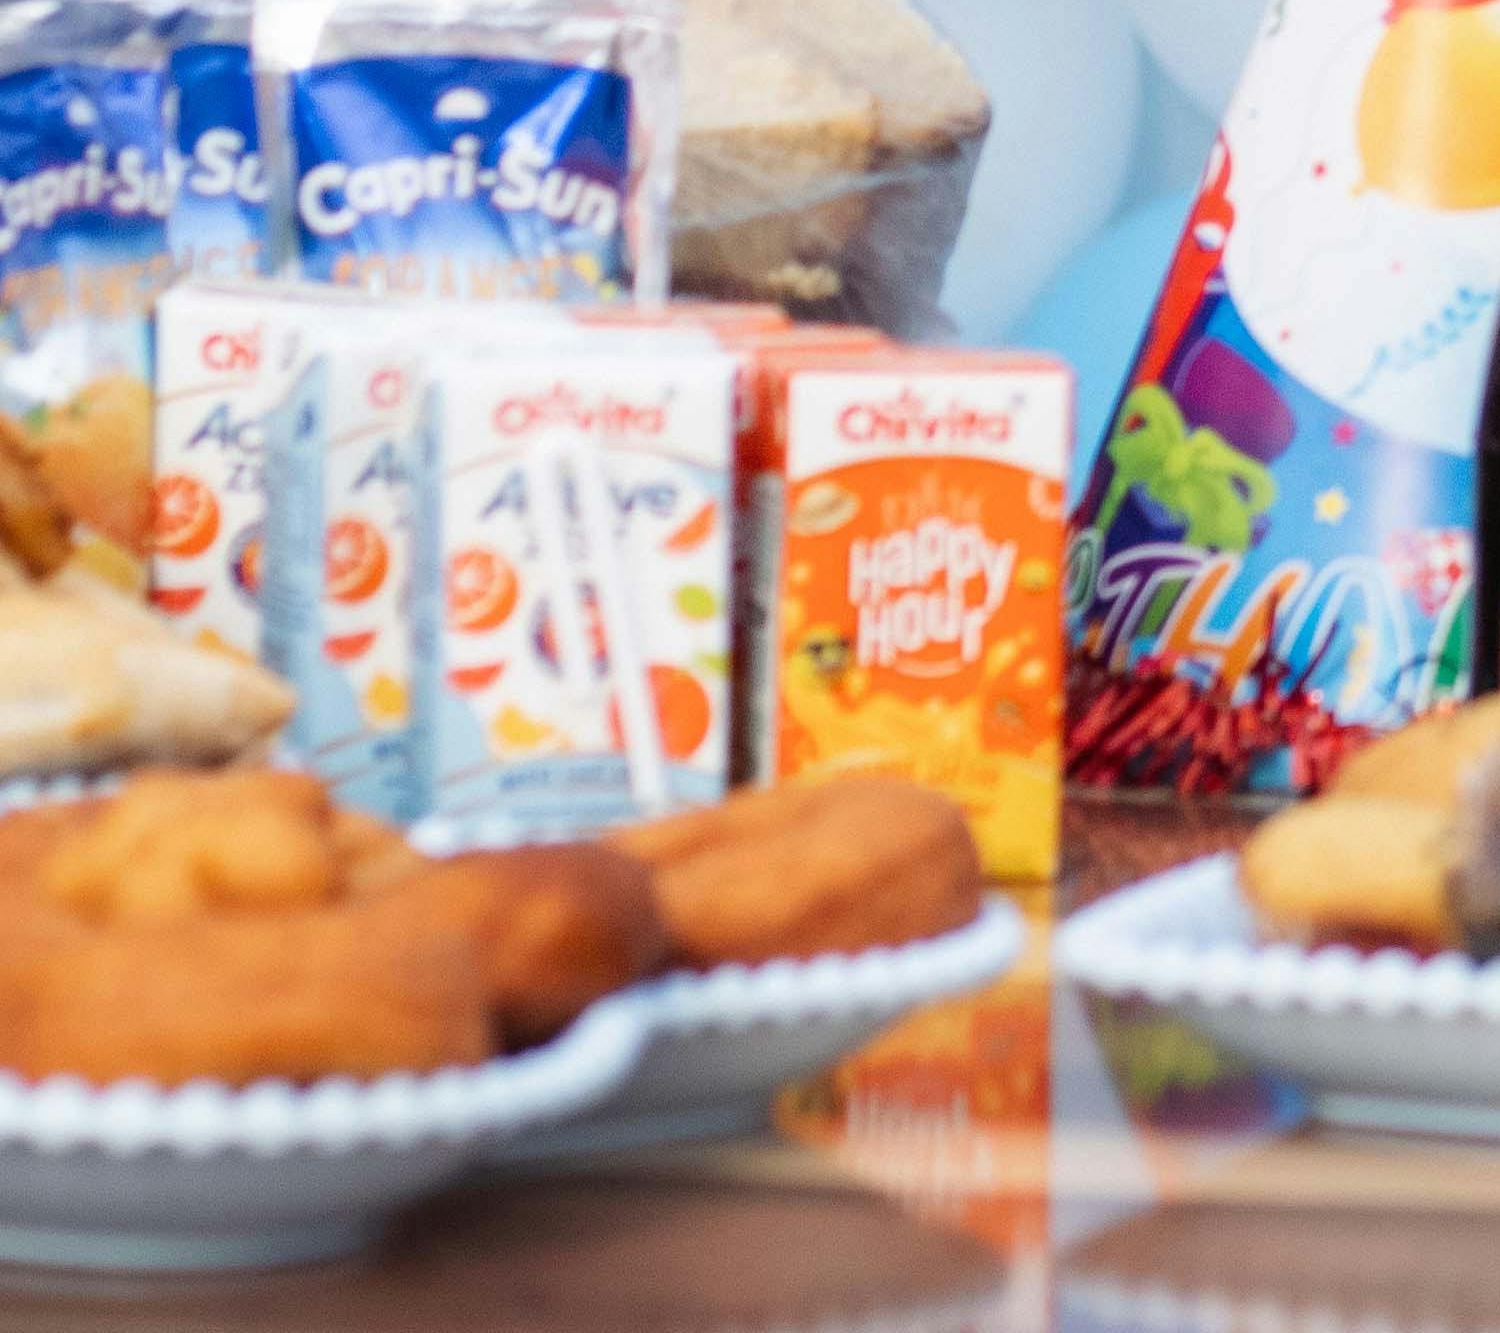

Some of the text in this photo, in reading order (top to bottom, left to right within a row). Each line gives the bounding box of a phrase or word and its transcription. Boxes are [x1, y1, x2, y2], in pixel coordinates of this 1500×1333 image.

[299, 133, 618, 237] Capri-Sun
[846, 516, 1020, 623] Happy
[856, 590, 986, 670] Hour
